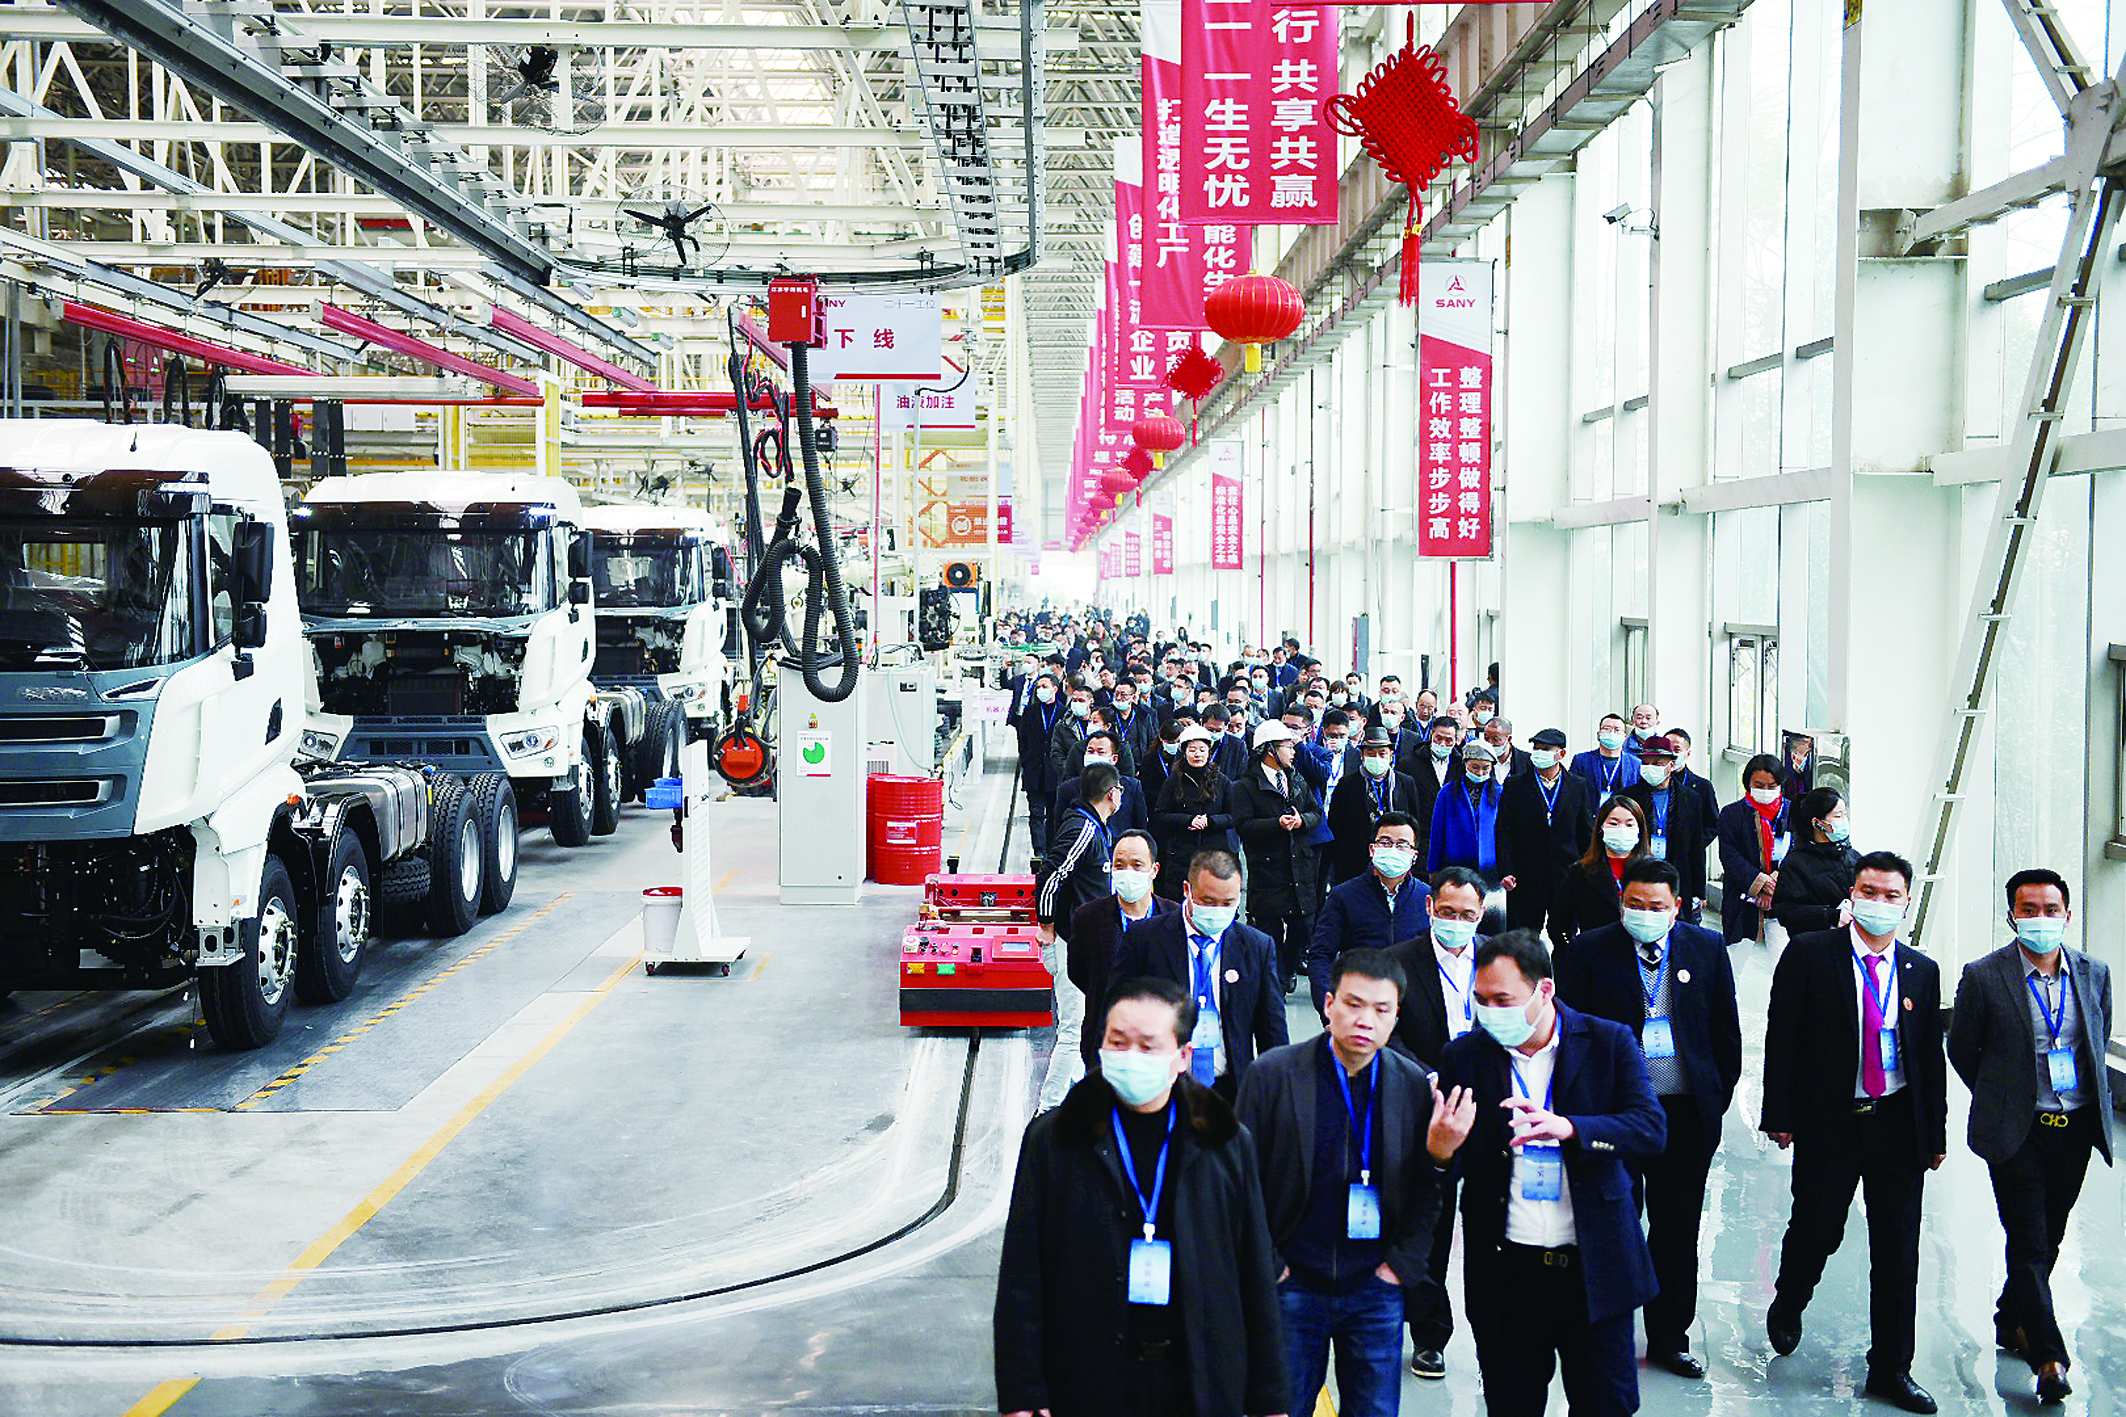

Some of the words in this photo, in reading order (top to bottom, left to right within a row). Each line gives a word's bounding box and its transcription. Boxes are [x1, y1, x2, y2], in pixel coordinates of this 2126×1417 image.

[834, 328, 895, 350] 下线
[1435, 299, 1476, 308] SANY
[1428, 368, 1452, 540] 工作效率步步高
[1458, 366, 1483, 539] 整理整顿做得好
